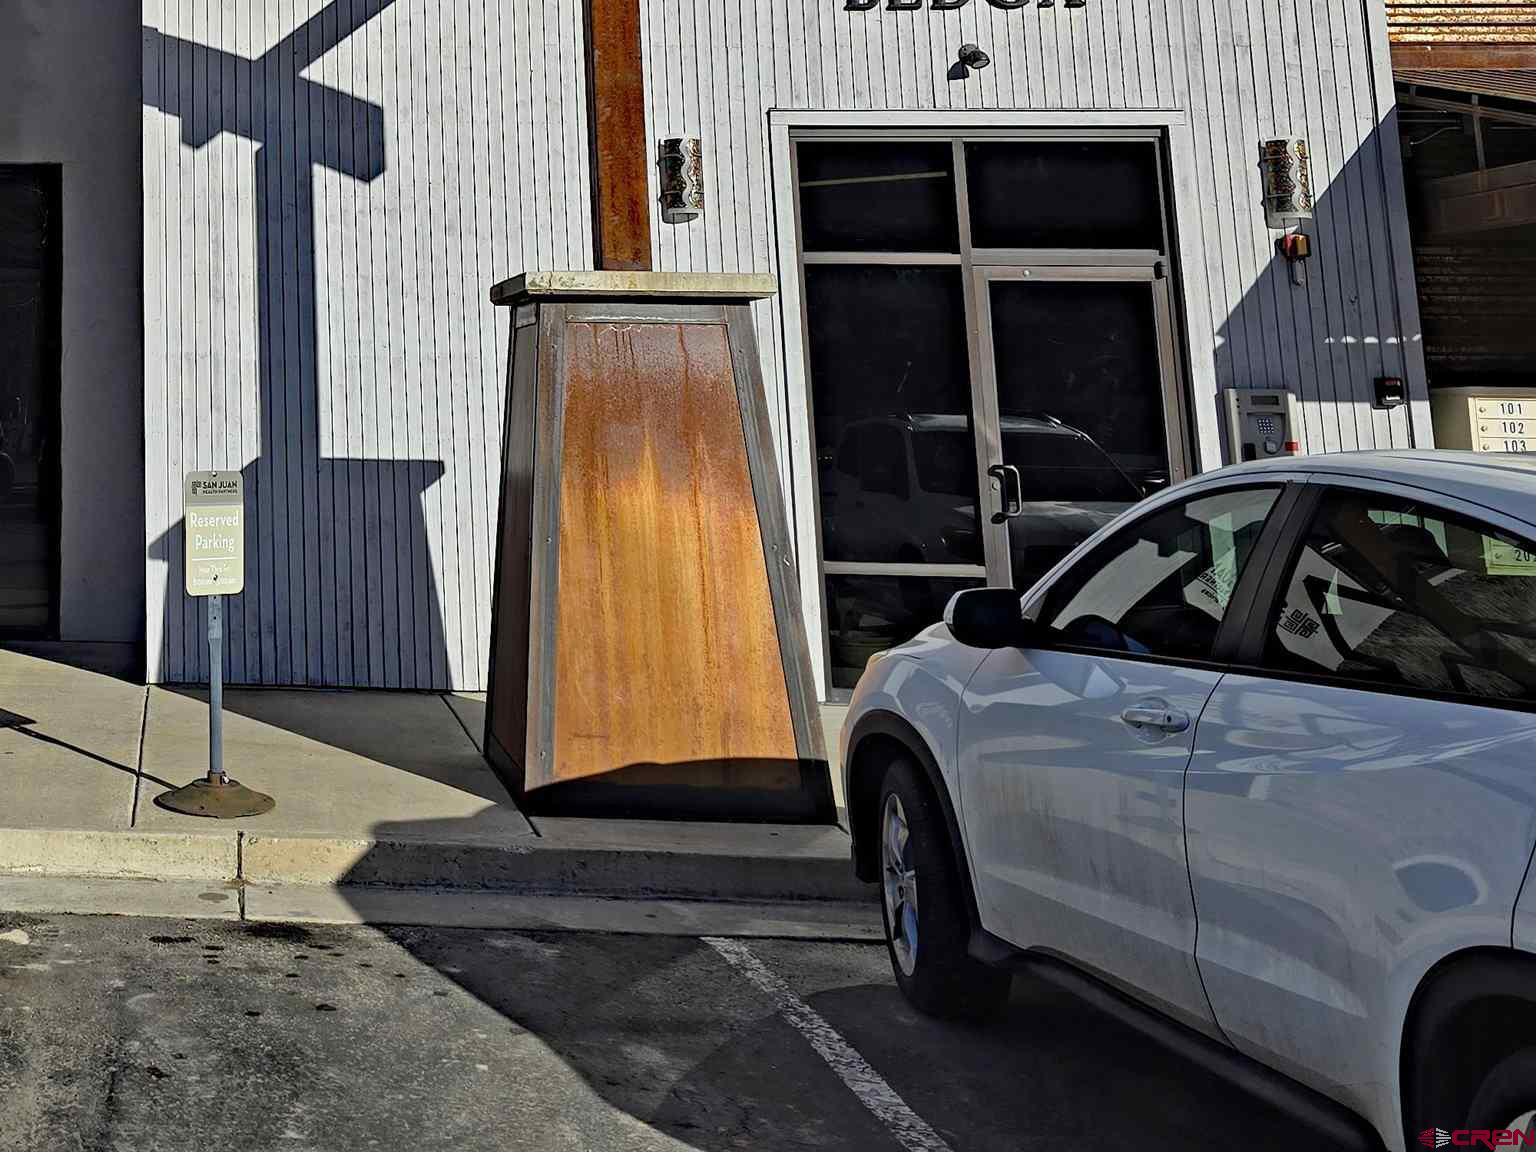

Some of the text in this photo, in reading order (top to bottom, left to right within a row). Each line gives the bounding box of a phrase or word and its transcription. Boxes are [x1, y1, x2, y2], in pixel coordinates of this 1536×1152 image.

[1500, 402, 1522, 415] 101
[1502, 421, 1524, 434] 102
[1504, 439, 1527, 453] 103
[203, 480, 238, 489] SAN JUAN
[190, 510, 239, 527] Reserved
[194, 533, 234, 552] Parking
